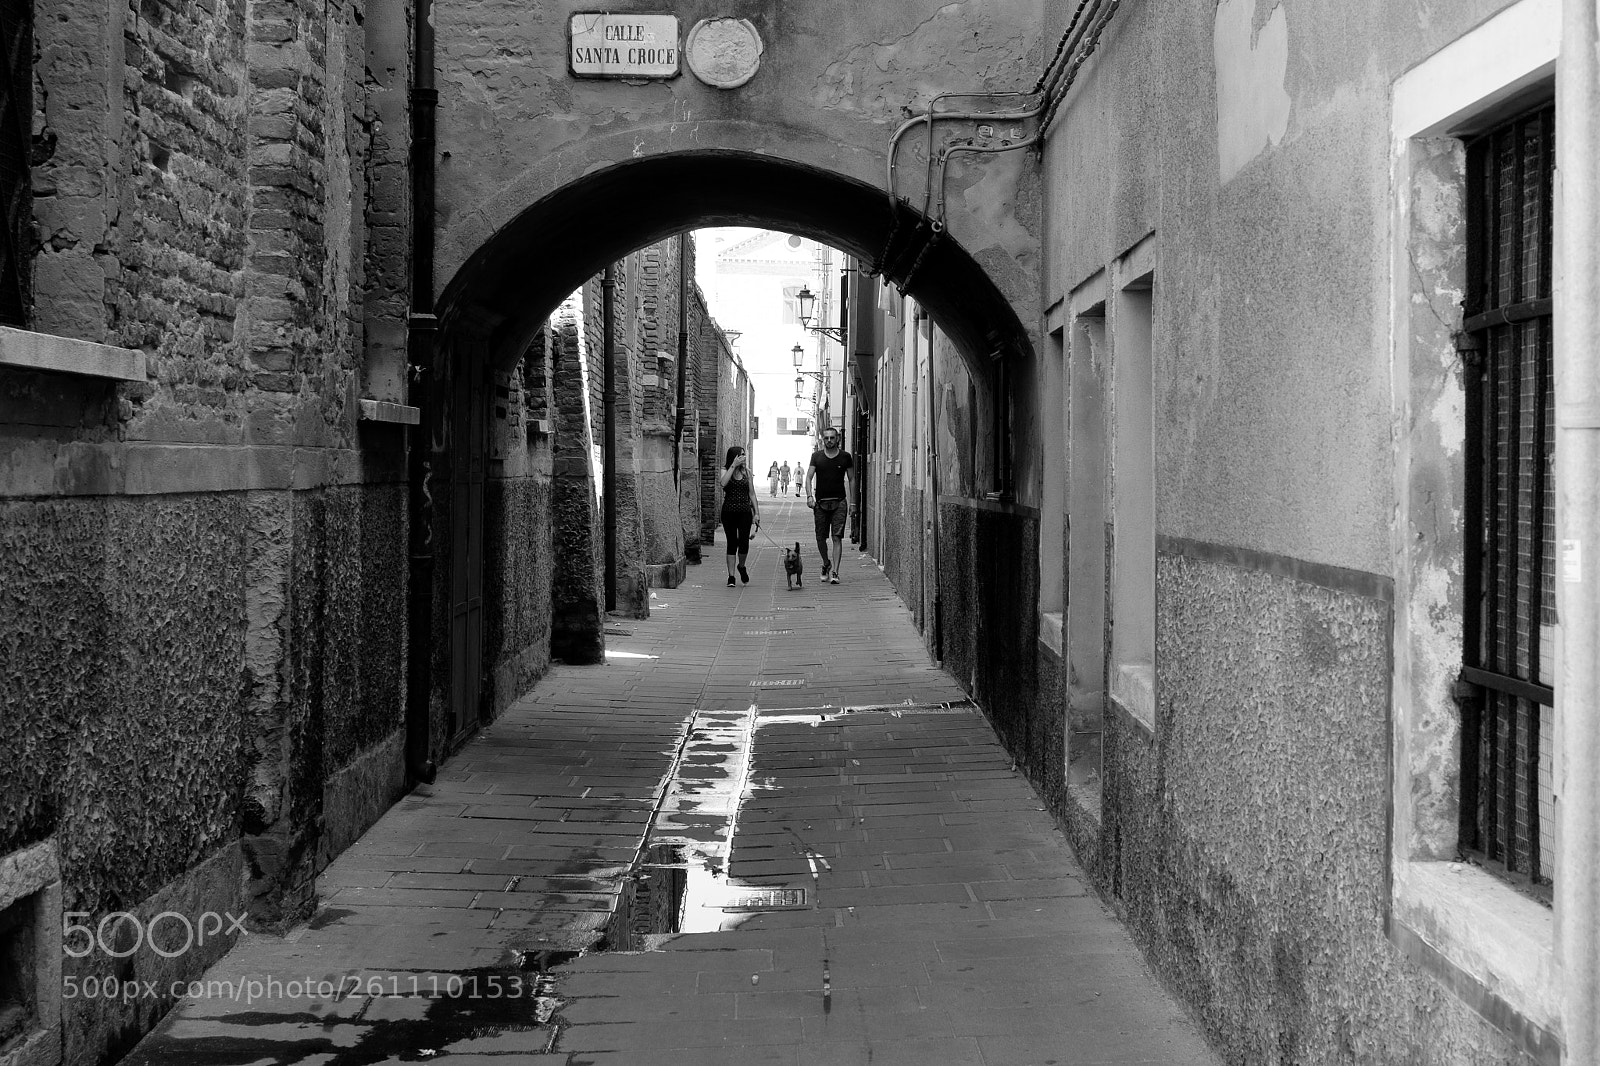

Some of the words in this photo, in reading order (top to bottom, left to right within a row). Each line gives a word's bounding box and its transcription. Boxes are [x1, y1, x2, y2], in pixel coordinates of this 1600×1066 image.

[605, 25, 645, 42] CALLE
[575, 47, 620, 64] SANTA
[628, 48, 675, 65] CROCE
